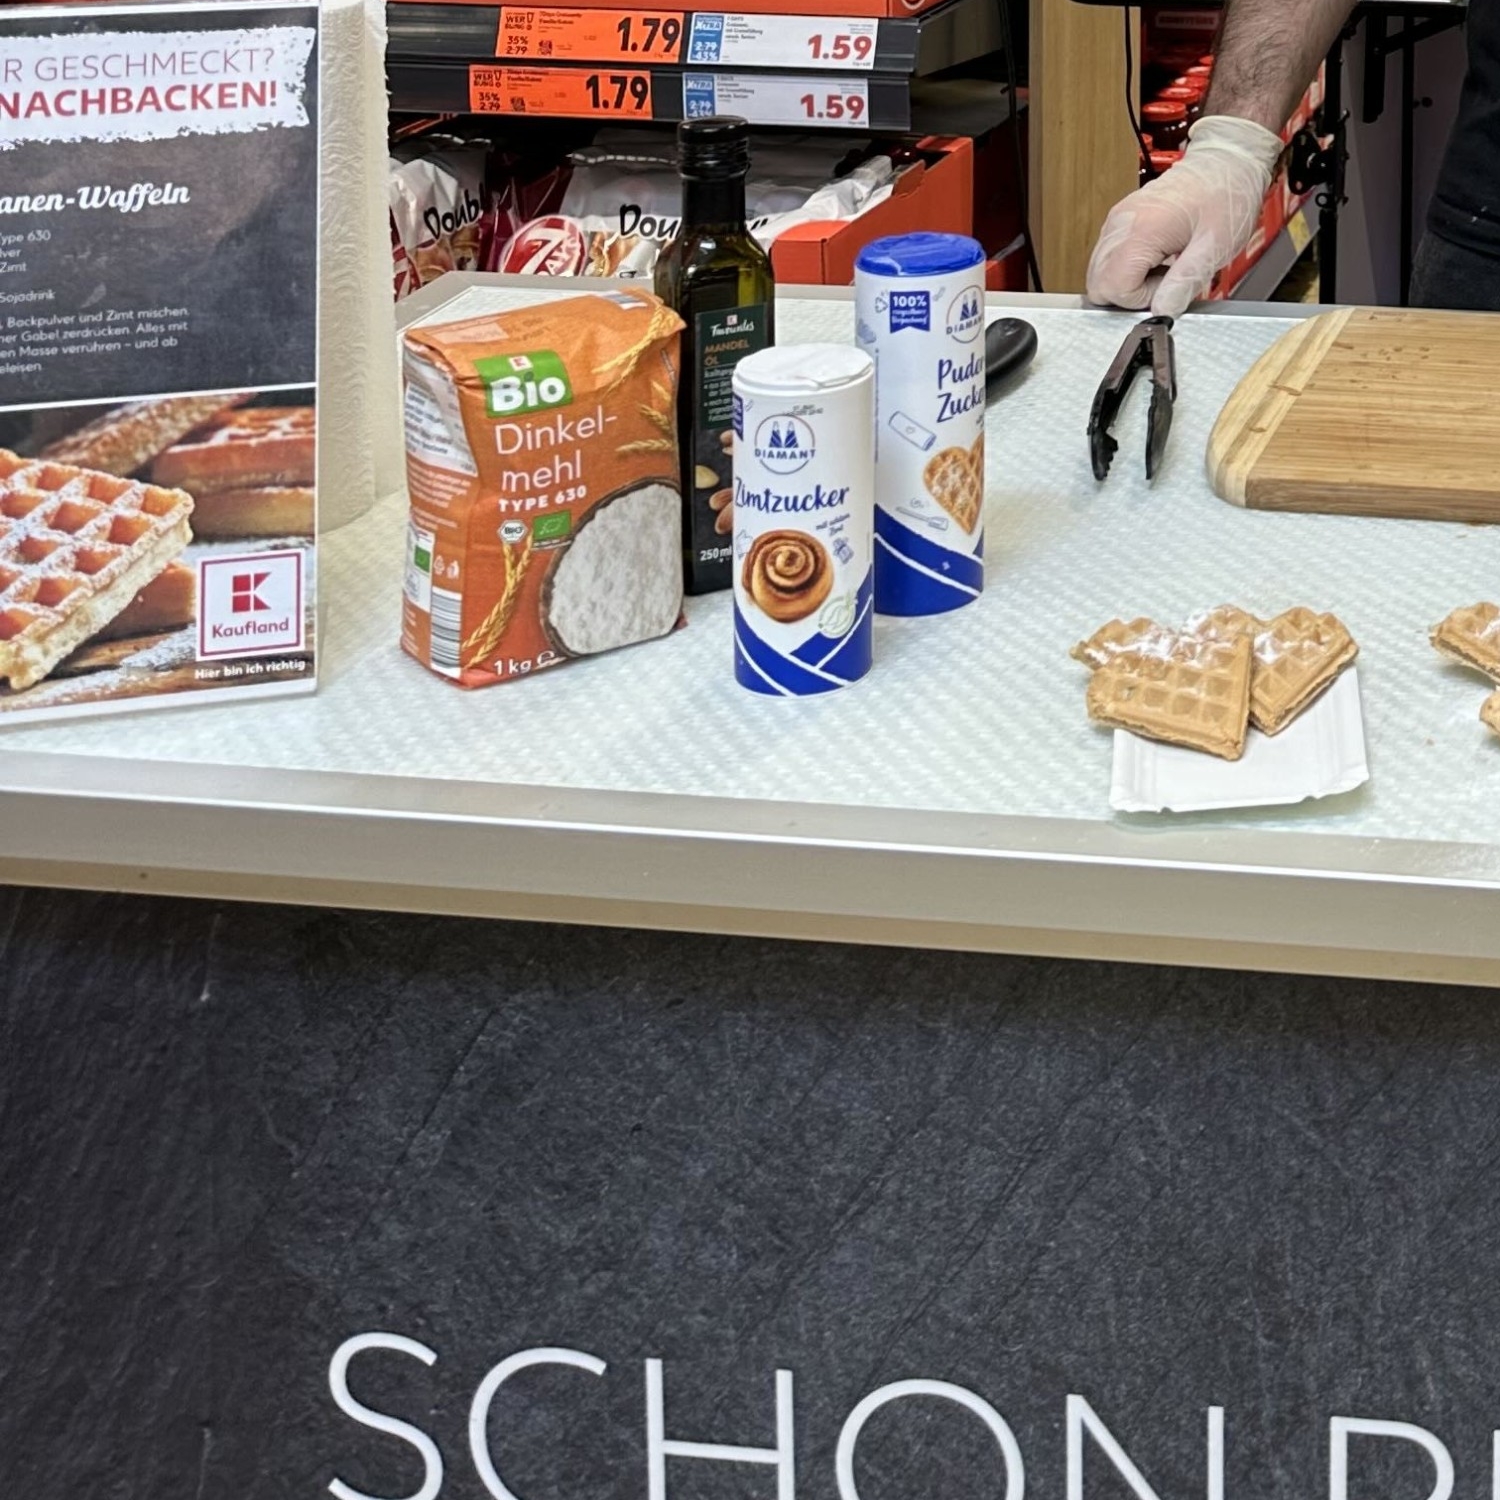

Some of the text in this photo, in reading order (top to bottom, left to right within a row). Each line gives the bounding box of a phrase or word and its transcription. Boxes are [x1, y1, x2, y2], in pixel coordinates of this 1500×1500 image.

[506, 15, 526, 24] WER
[507, 36, 529, 45] 35%
[617, 17, 681, 53] 1.79
[506, 45, 528, 55] 2.79
[808, 34, 872, 60] 1.59
[4, 49, 275, 83] R GESCHMECKT?
[0, 80, 277, 119] NACHBACKEN!
[479, 92, 500, 102] 35%
[586, 75, 649, 110] 1.79
[479, 101, 501, 111] 2.79
[801, 93, 865, 120] 1.59
[27, 229, 52, 242] 630
[0, 261, 27, 274] Zimt
[0, 289, 56, 305] Sojadrink
[892, 294, 928, 308] 100%
[7, 313, 76, 330] Backpulver
[78, 312, 103, 324] und
[106, 308, 134, 322] Zimt
[946, 315, 984, 335] DIAMAN
[21, 320, 188, 343] Gabel Alles mit
[19, 345, 59, 358] Masse
[61, 341, 122, 355] verrühren
[134, 337, 159, 350] und
[161, 335, 179, 348] ab
[704, 339, 750, 354] MANDEL
[704, 355, 719, 367] ÖL
[489, 372, 566, 413] Bio
[494, 405, 618, 455] Dinkel-
[754, 449, 817, 460] DIAMANT
[501, 450, 582, 493] mehl
[498, 484, 587, 513] TYPE 630
[735, 476, 850, 514] Zimtzucker
[700, 545, 732, 562] 250 ml
[211, 616, 290, 639] Kaufland
[194, 658, 306, 680] Hier bin ich richtig
[494, 658, 533, 676] 1 kg
[328, 1331, 1225, 1500] SCHON
